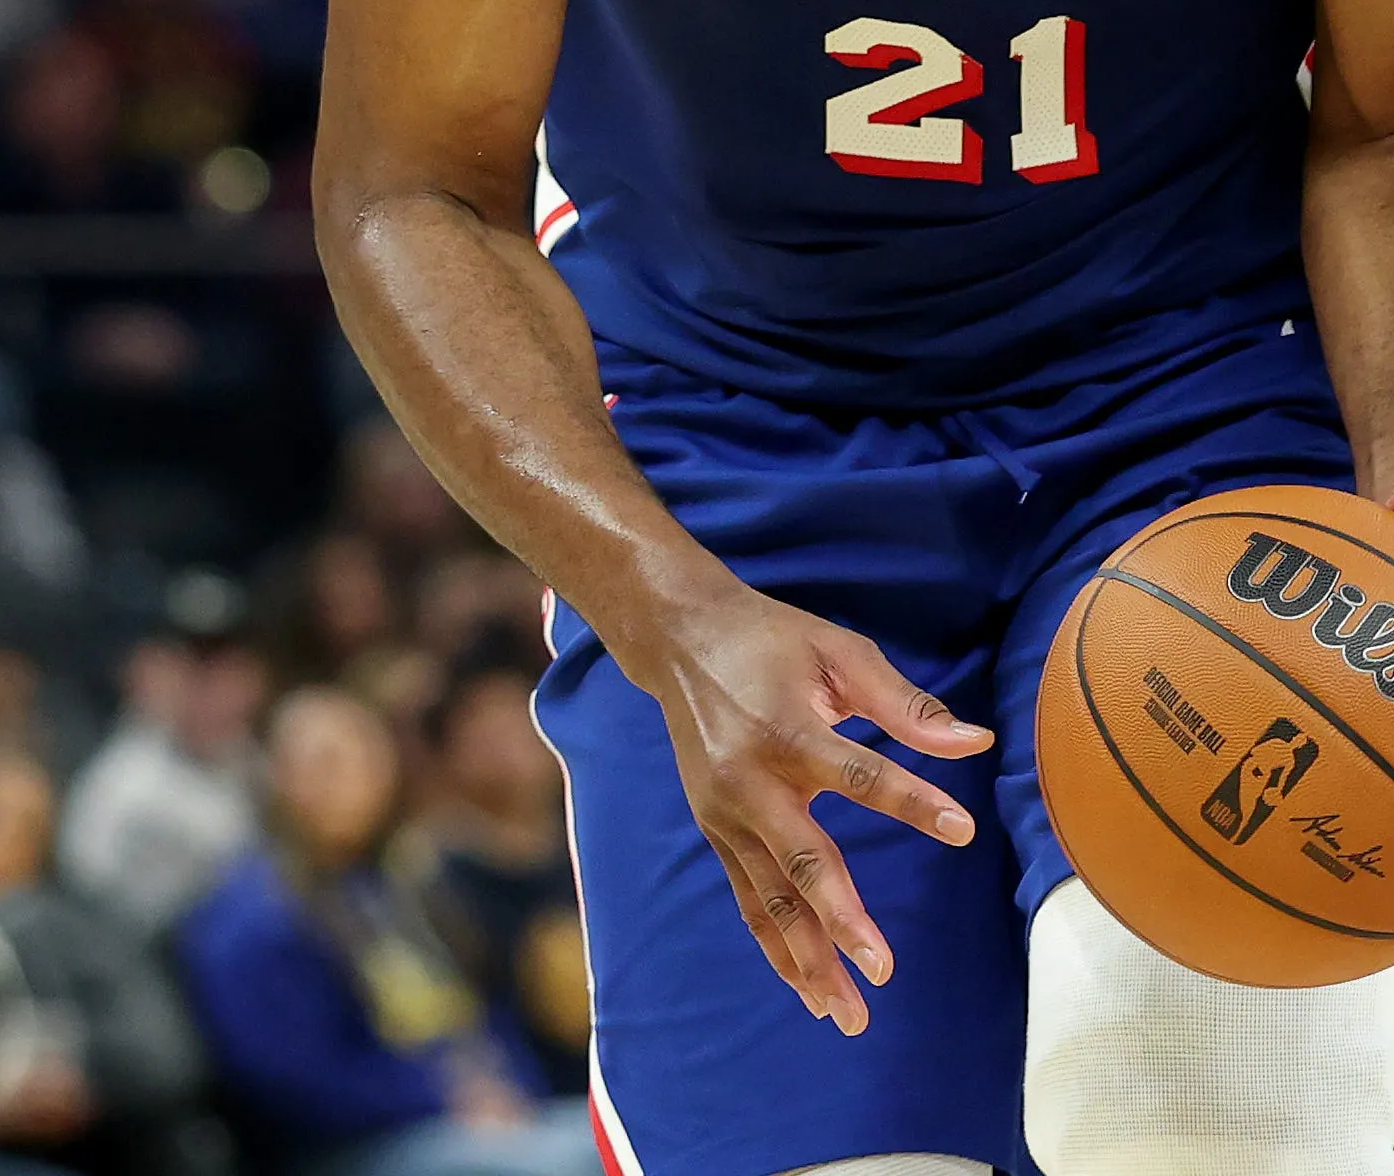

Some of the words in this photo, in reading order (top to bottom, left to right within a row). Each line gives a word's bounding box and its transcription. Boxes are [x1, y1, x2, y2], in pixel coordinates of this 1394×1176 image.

[824, 15, 1100, 185] 21
[1143, 667, 1182, 711] OFFICIAL
[1174, 700, 1206, 736] GAME
[1197, 724, 1227, 756] BALL
[1205, 799, 1238, 830] NBA
